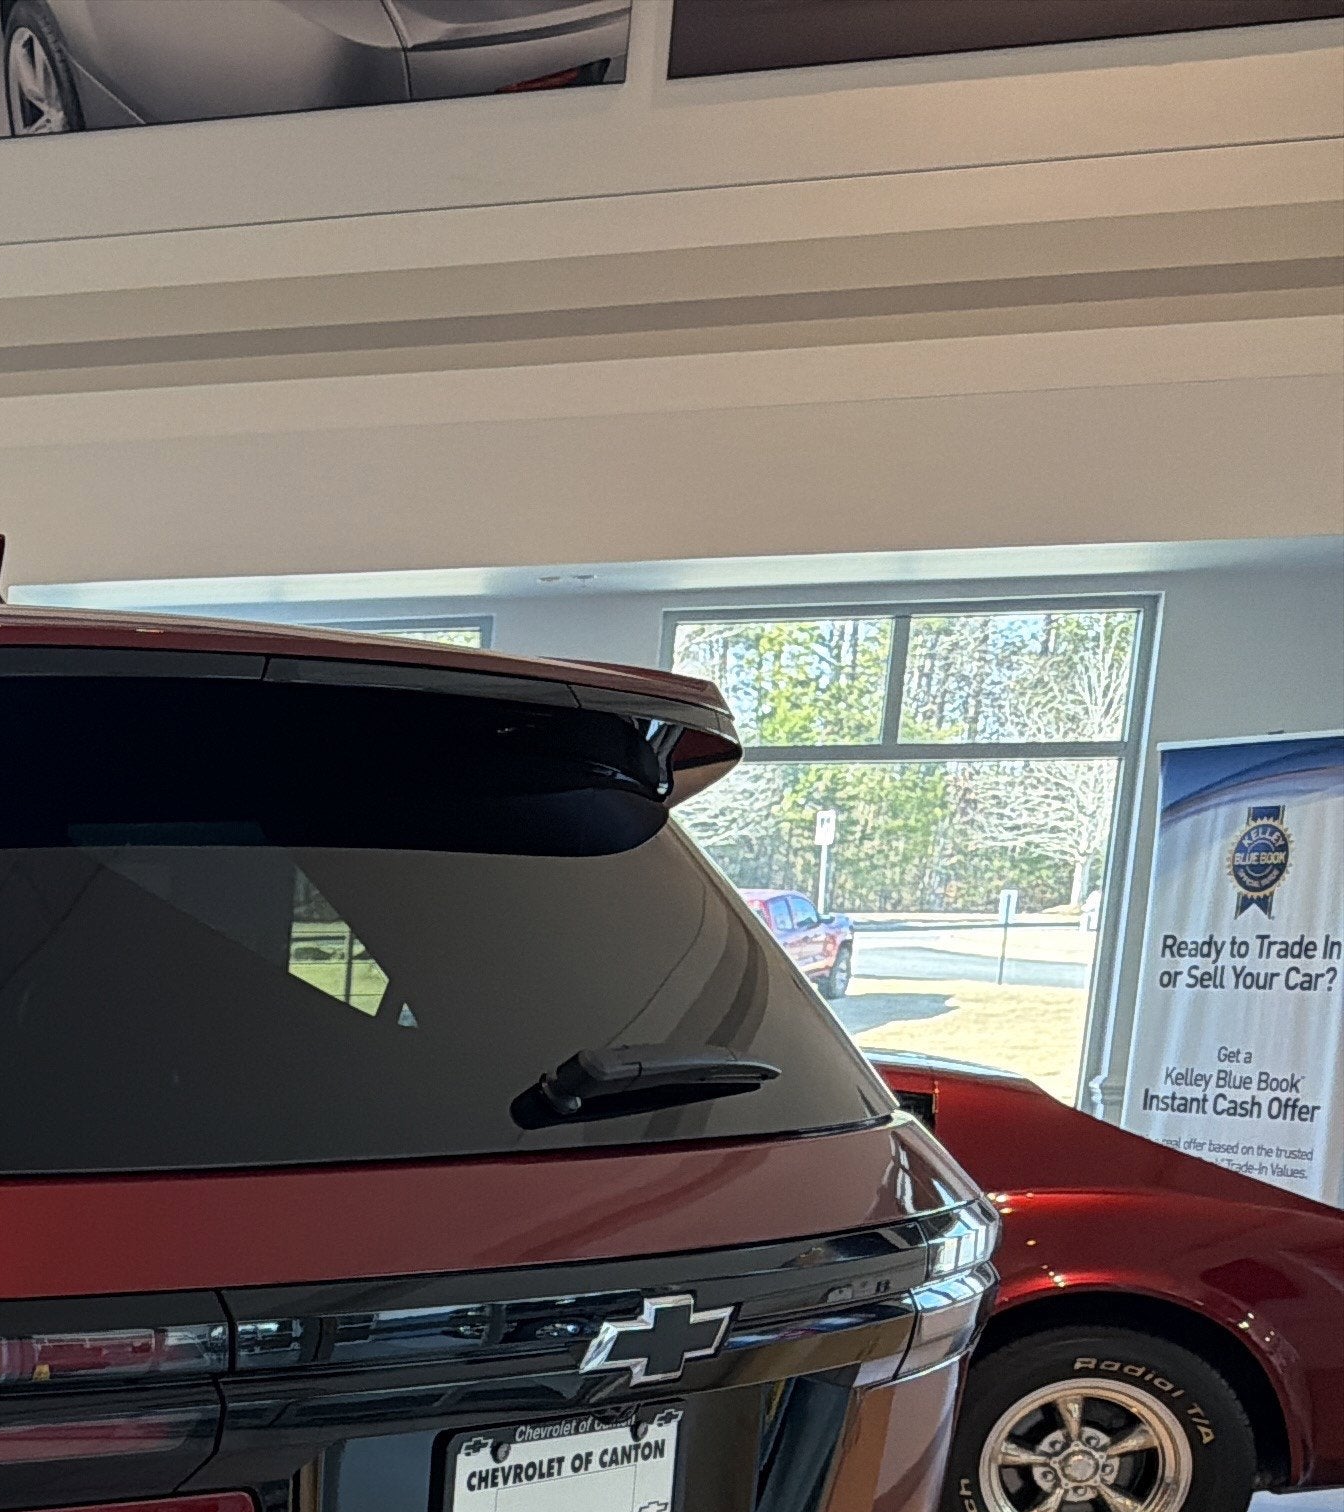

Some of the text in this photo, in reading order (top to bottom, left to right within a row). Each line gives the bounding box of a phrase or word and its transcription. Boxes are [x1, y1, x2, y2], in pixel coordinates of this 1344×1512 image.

[1242, 827, 1286, 847] KELLEY
[1161, 934, 1342, 964] Ready to Trade In
[1159, 964, 1338, 992] or Sell Your Car?
[1217, 1045, 1252, 1064] Get a
[1164, 1066, 1213, 1092] Kelley
[1215, 1069, 1253, 1090] Blue
[1142, 1088, 1321, 1123] Instant Cash Offer
[1183, 1137, 1206, 1151] offer
[1208, 1139, 1239, 1154] based
[1241, 1145, 1254, 1155] on
[1256, 1144, 1273, 1158] the
[1276, 1146, 1314, 1161] trusted
[1270, 1163, 1308, 1179] Values.
[1073, 1357, 1215, 1445] Radial T/A
[514, 1420, 577, 1443] Chevrolet
[578, 1414, 593, 1432] of
[467, 1438, 666, 1492] CHEVROLET OF CANTON
